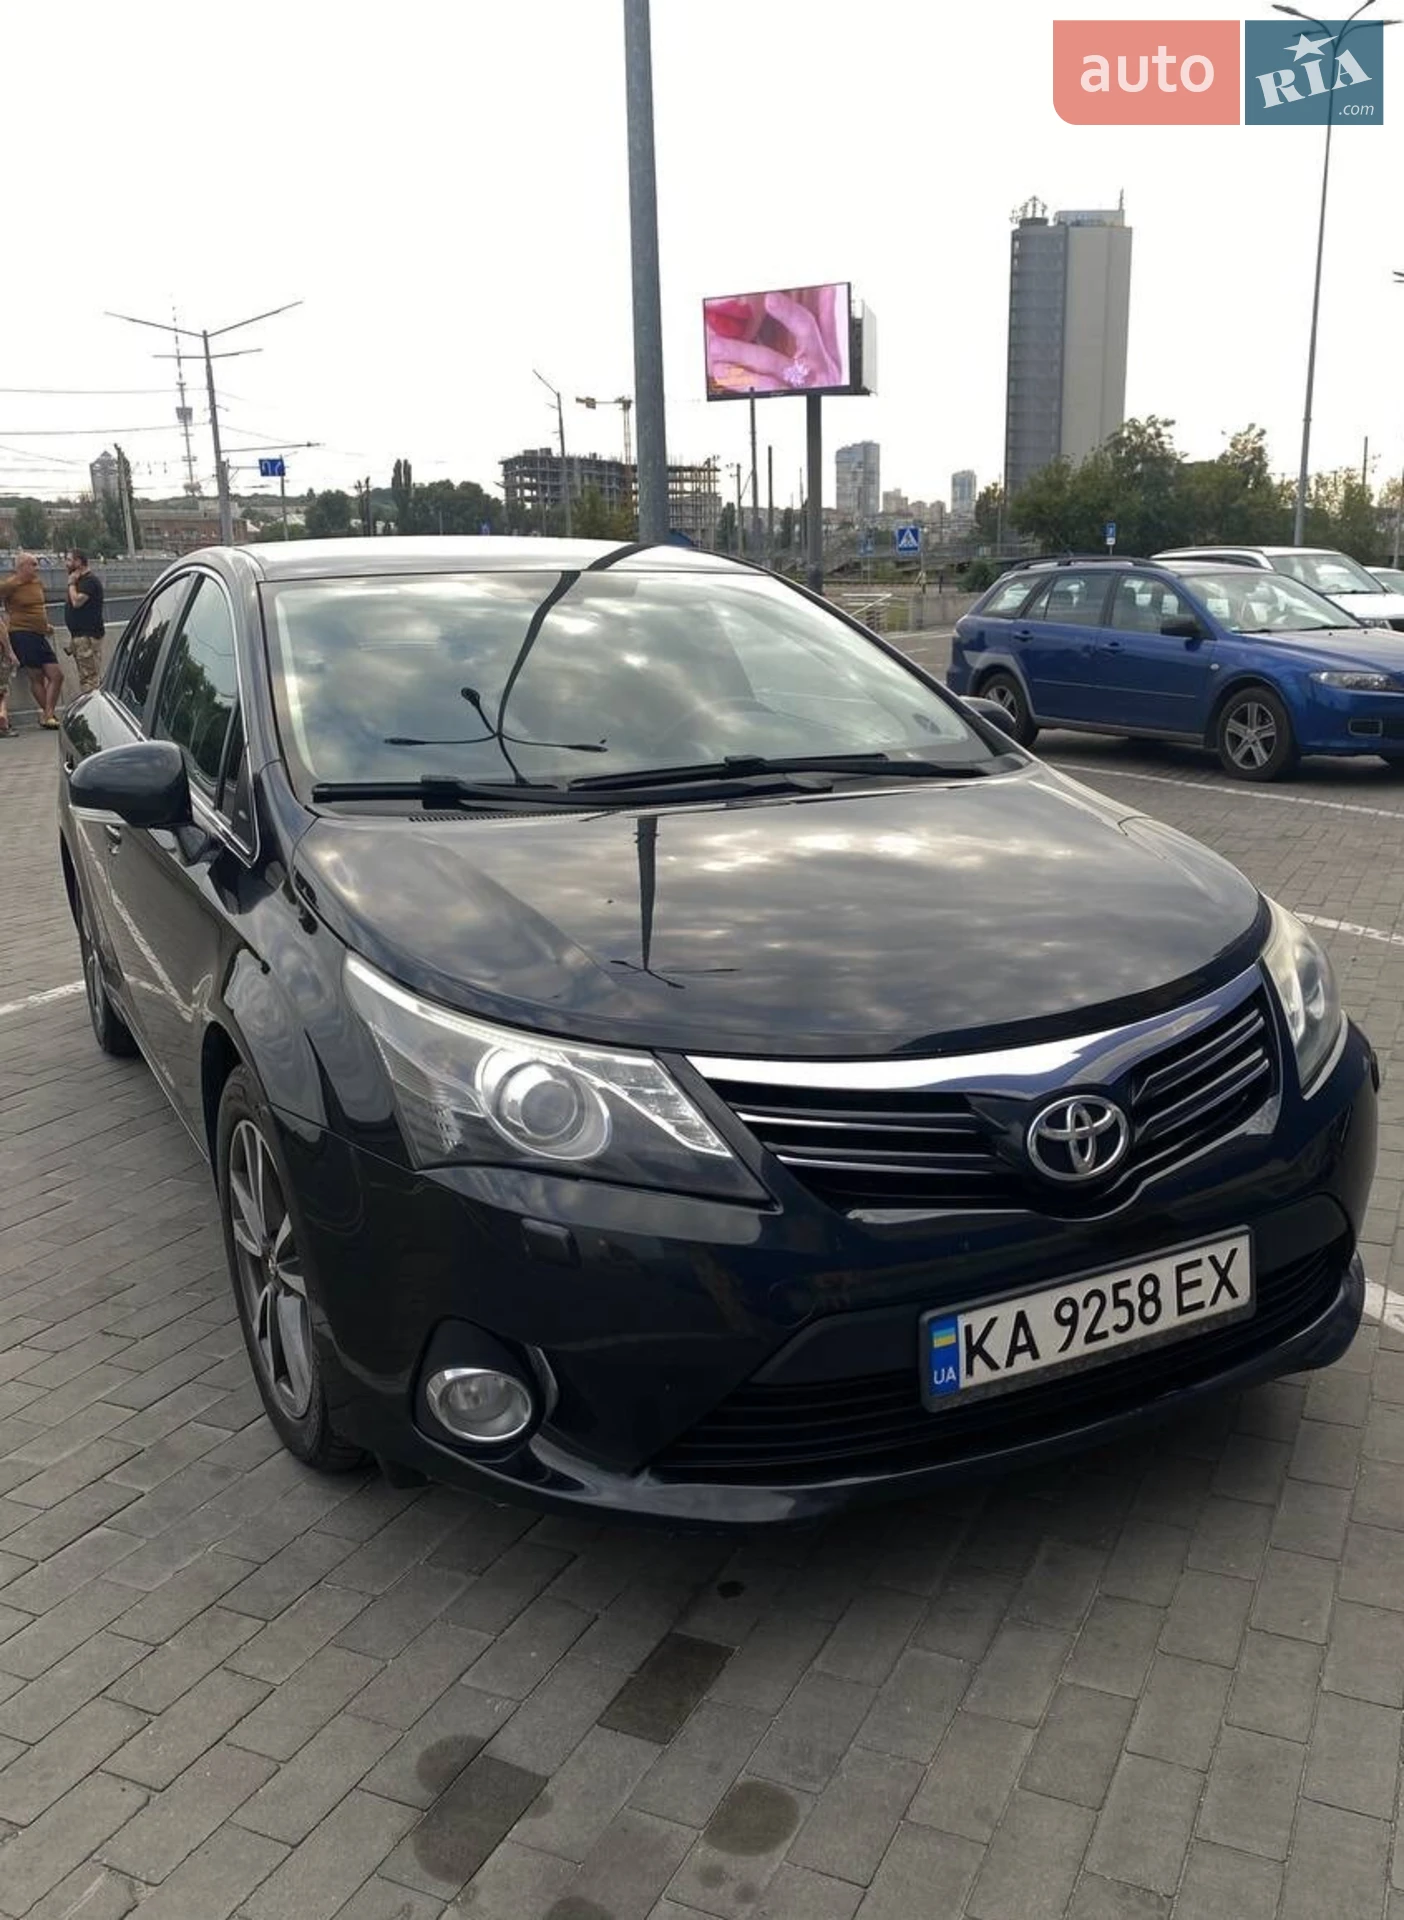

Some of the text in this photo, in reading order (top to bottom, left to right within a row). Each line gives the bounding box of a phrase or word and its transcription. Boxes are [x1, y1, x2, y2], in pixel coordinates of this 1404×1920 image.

[964, 1247, 1239, 1377] KA 9258 EX
[933, 1366, 957, 1386] UA
